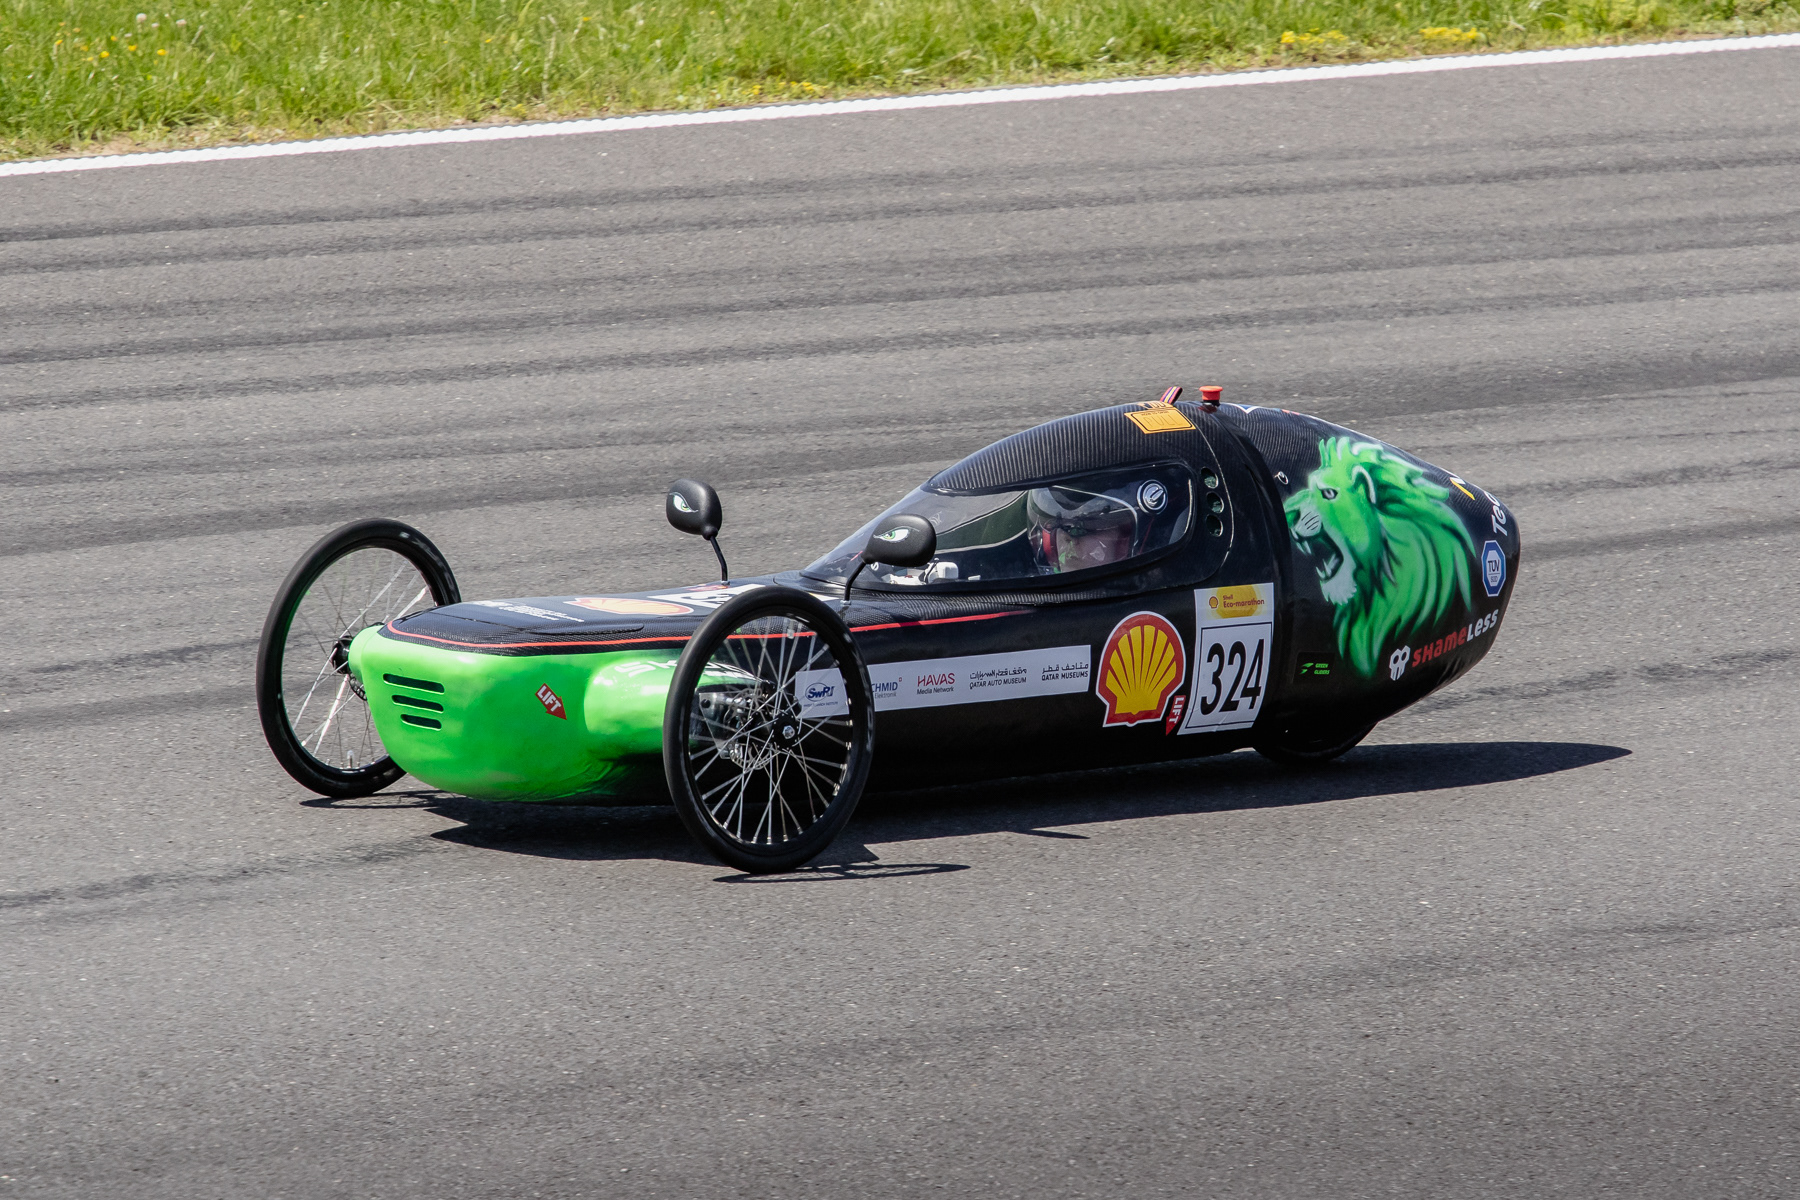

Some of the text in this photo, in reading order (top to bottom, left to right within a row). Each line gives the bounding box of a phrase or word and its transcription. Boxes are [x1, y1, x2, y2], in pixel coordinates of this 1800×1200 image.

[1223, 598, 1265, 608] Eco-marathon
[917, 672, 956, 687] HAVAS
[1041, 670, 1089, 681] QATAR MUSEUMS
[1200, 638, 1265, 716] 324
[871, 681, 898, 693] CHMID
[916, 685, 955, 695] Media Network
[969, 676, 1027, 690] QATAR AUTO MUSEUM
[537, 685, 562, 712] LIFT
[1168, 697, 1185, 724] LIFT
